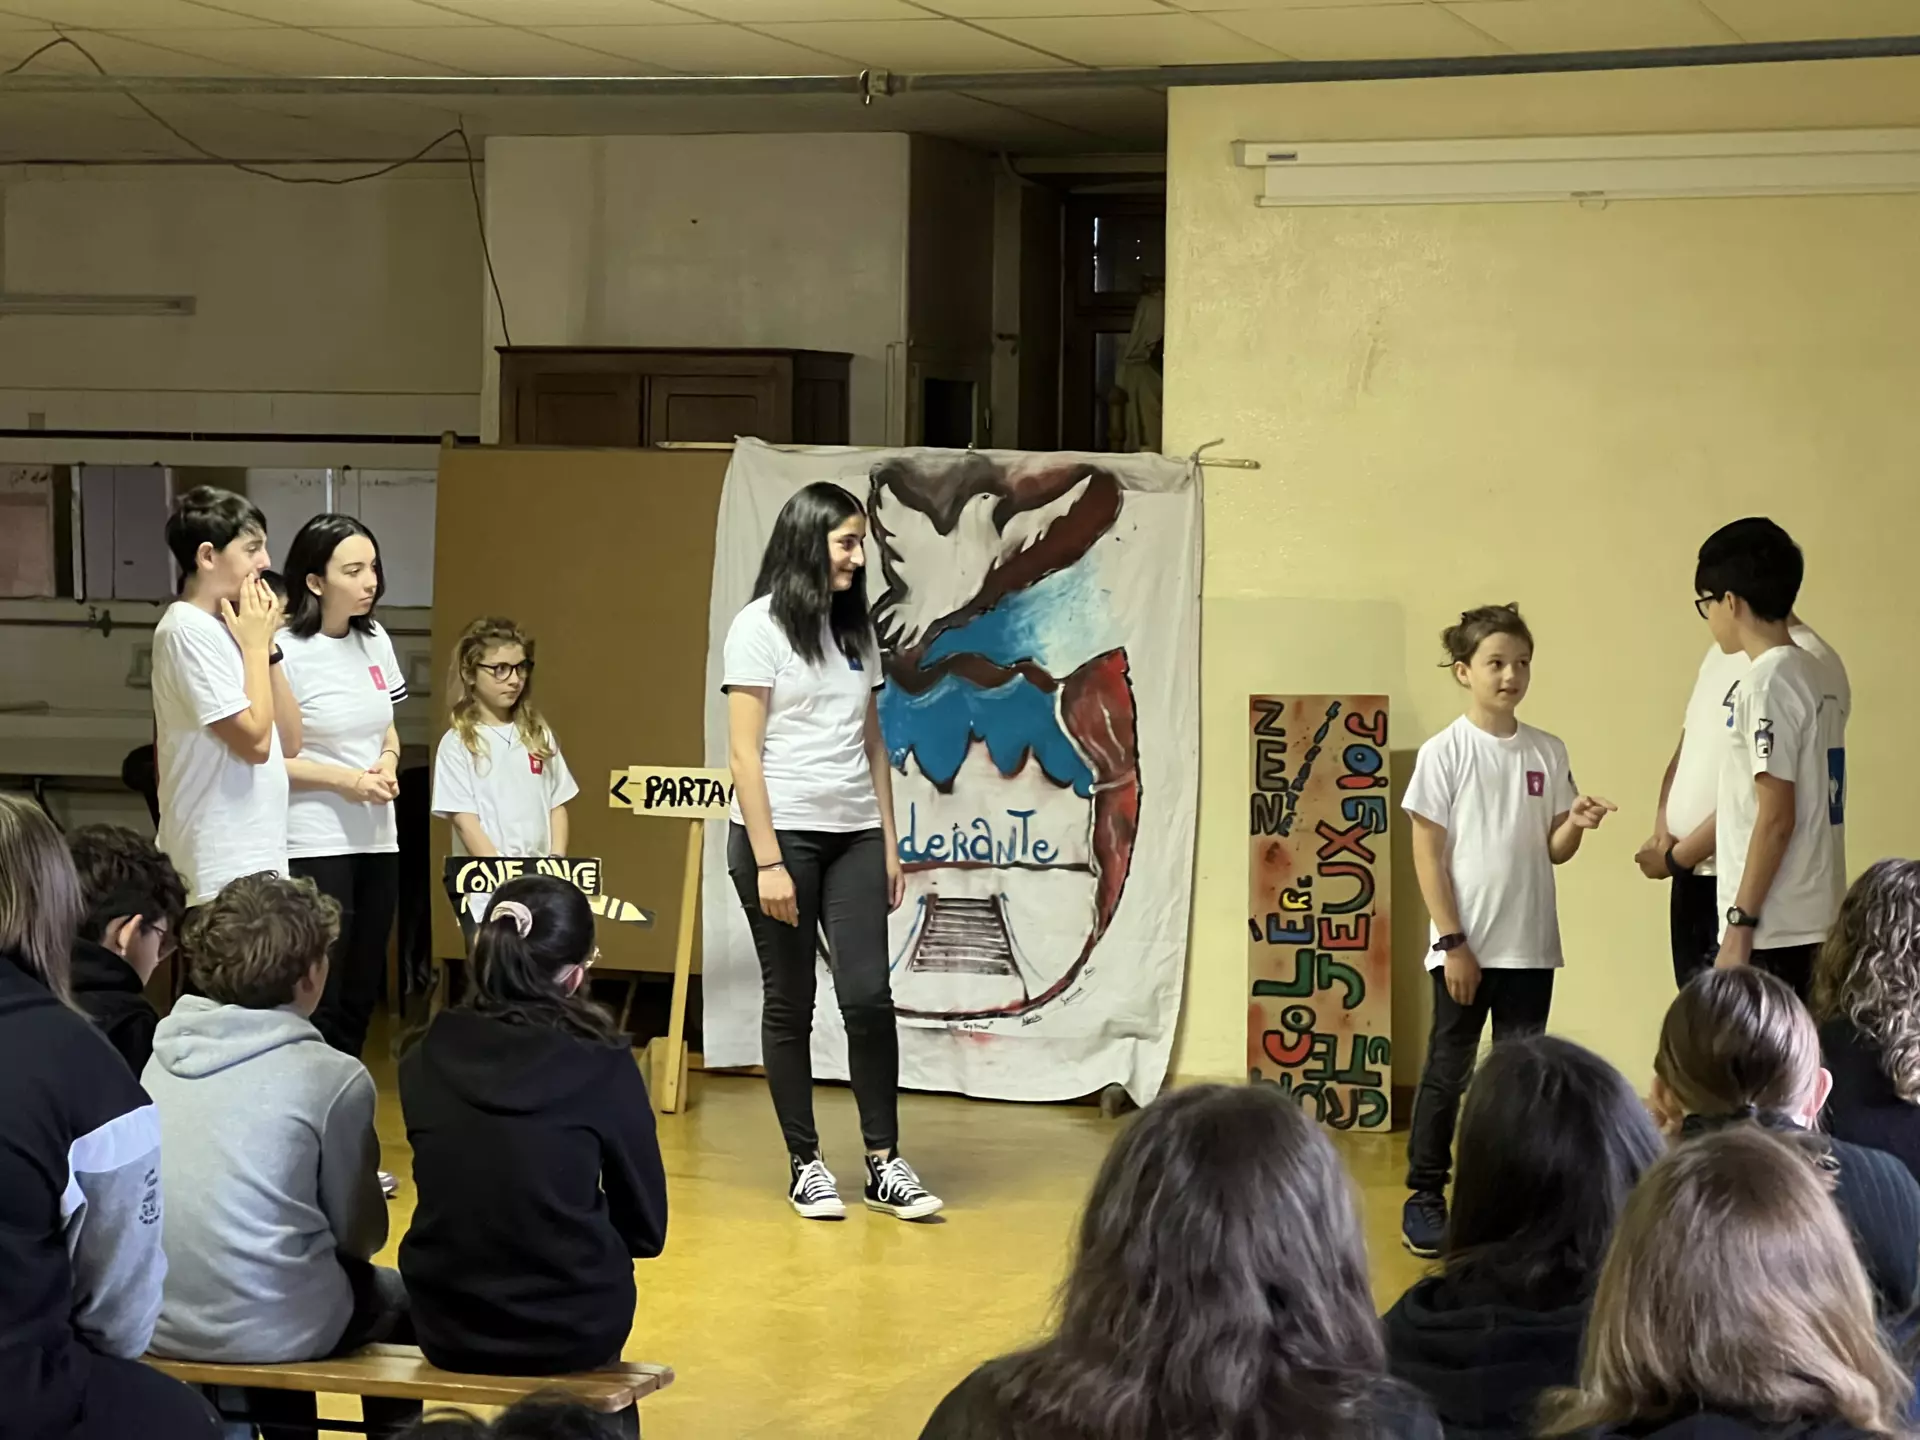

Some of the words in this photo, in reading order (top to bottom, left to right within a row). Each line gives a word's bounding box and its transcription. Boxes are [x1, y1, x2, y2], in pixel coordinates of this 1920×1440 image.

[644, 776, 734, 809] PARTA
[1250, 700, 1289, 836] ZEN
[1314, 819, 1377, 1010] JEUX
